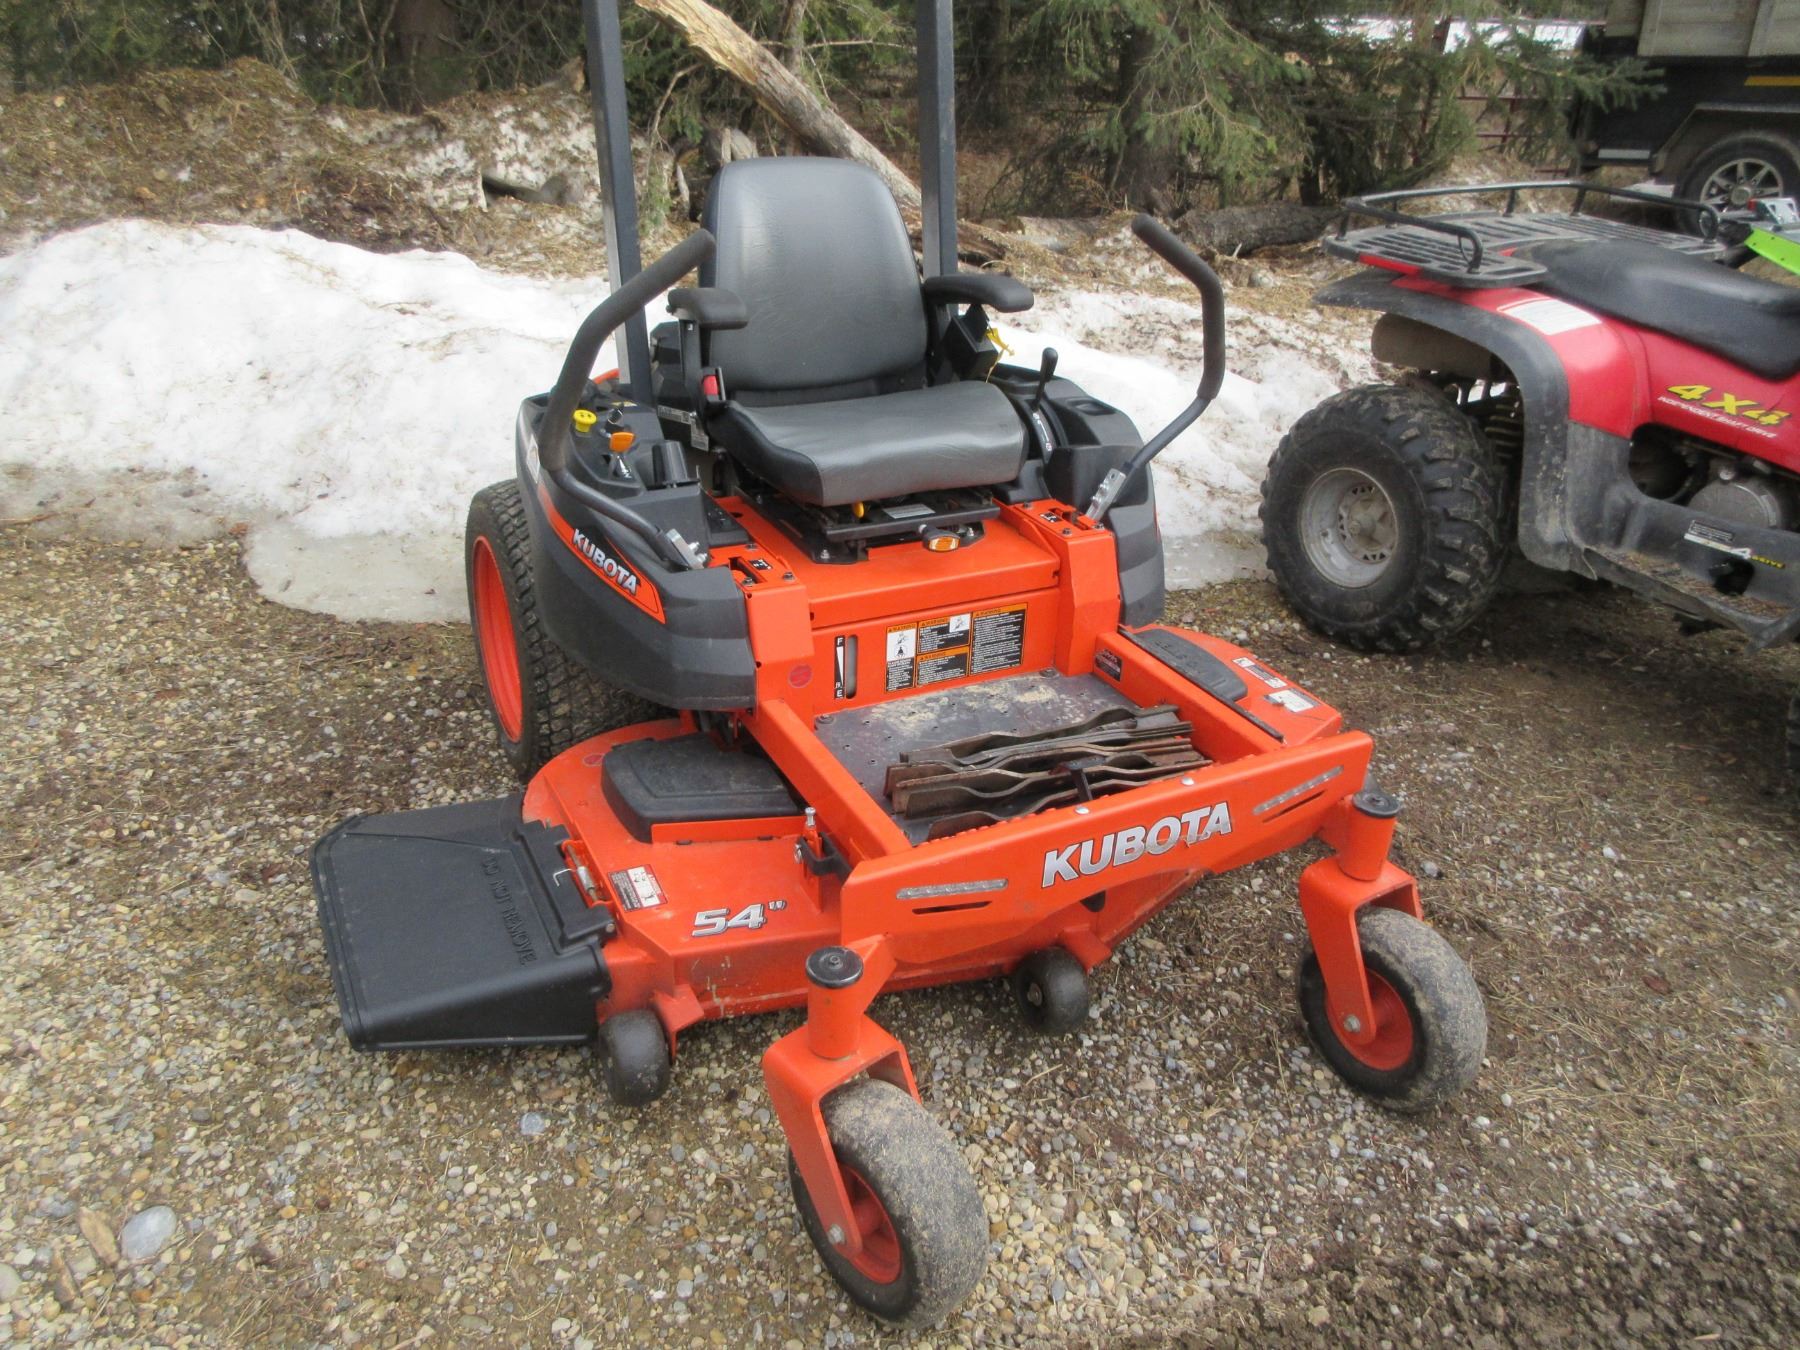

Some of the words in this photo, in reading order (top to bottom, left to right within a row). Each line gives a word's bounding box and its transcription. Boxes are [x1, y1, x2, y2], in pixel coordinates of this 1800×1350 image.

[572, 528, 639, 596] KUBOTA
[837, 637, 844, 646] F
[1041, 800, 1233, 888] KUBOTA
